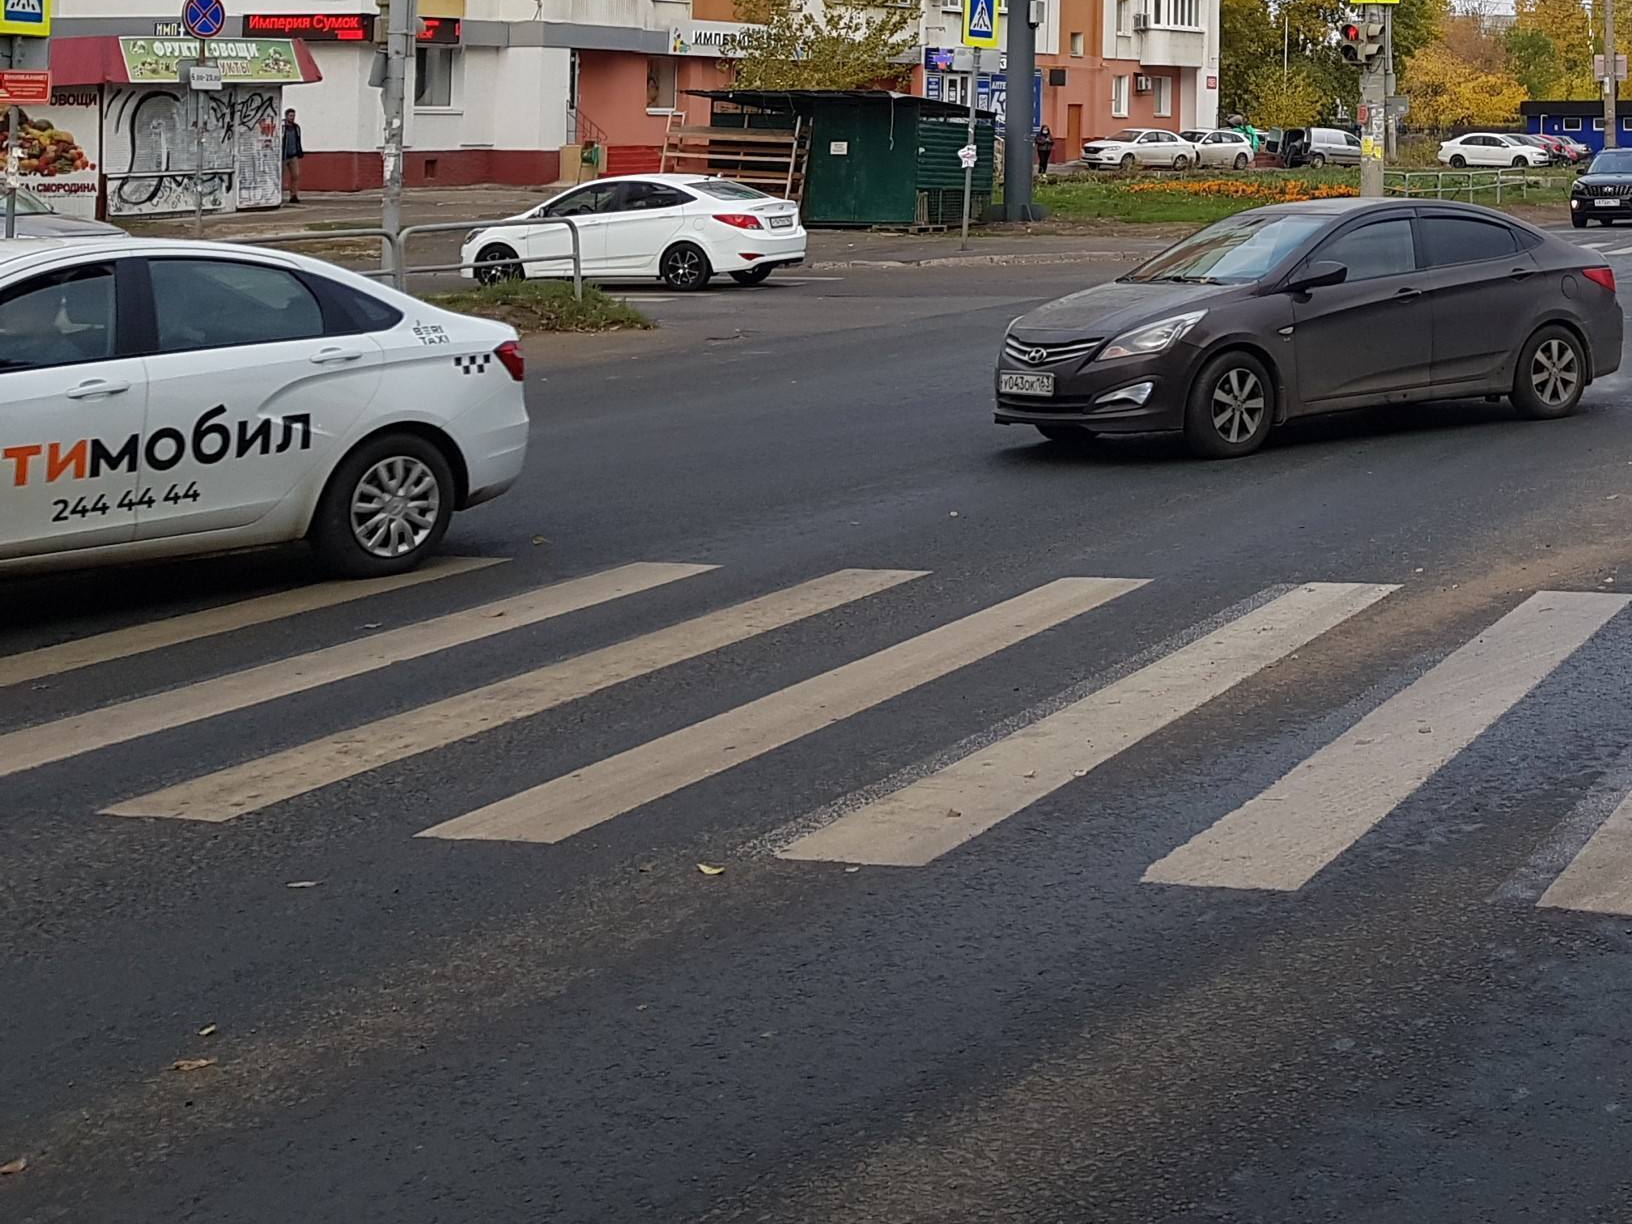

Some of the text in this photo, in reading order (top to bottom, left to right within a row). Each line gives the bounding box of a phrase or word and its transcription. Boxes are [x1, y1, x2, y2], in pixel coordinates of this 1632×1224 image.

[250, 16, 359, 33] Империя Сумок
[210, 42, 260, 60] ОВОЩИ
[37, 183, 97, 195] СМОРОДИНА
[52, 481, 201, 522] 244 44 44
